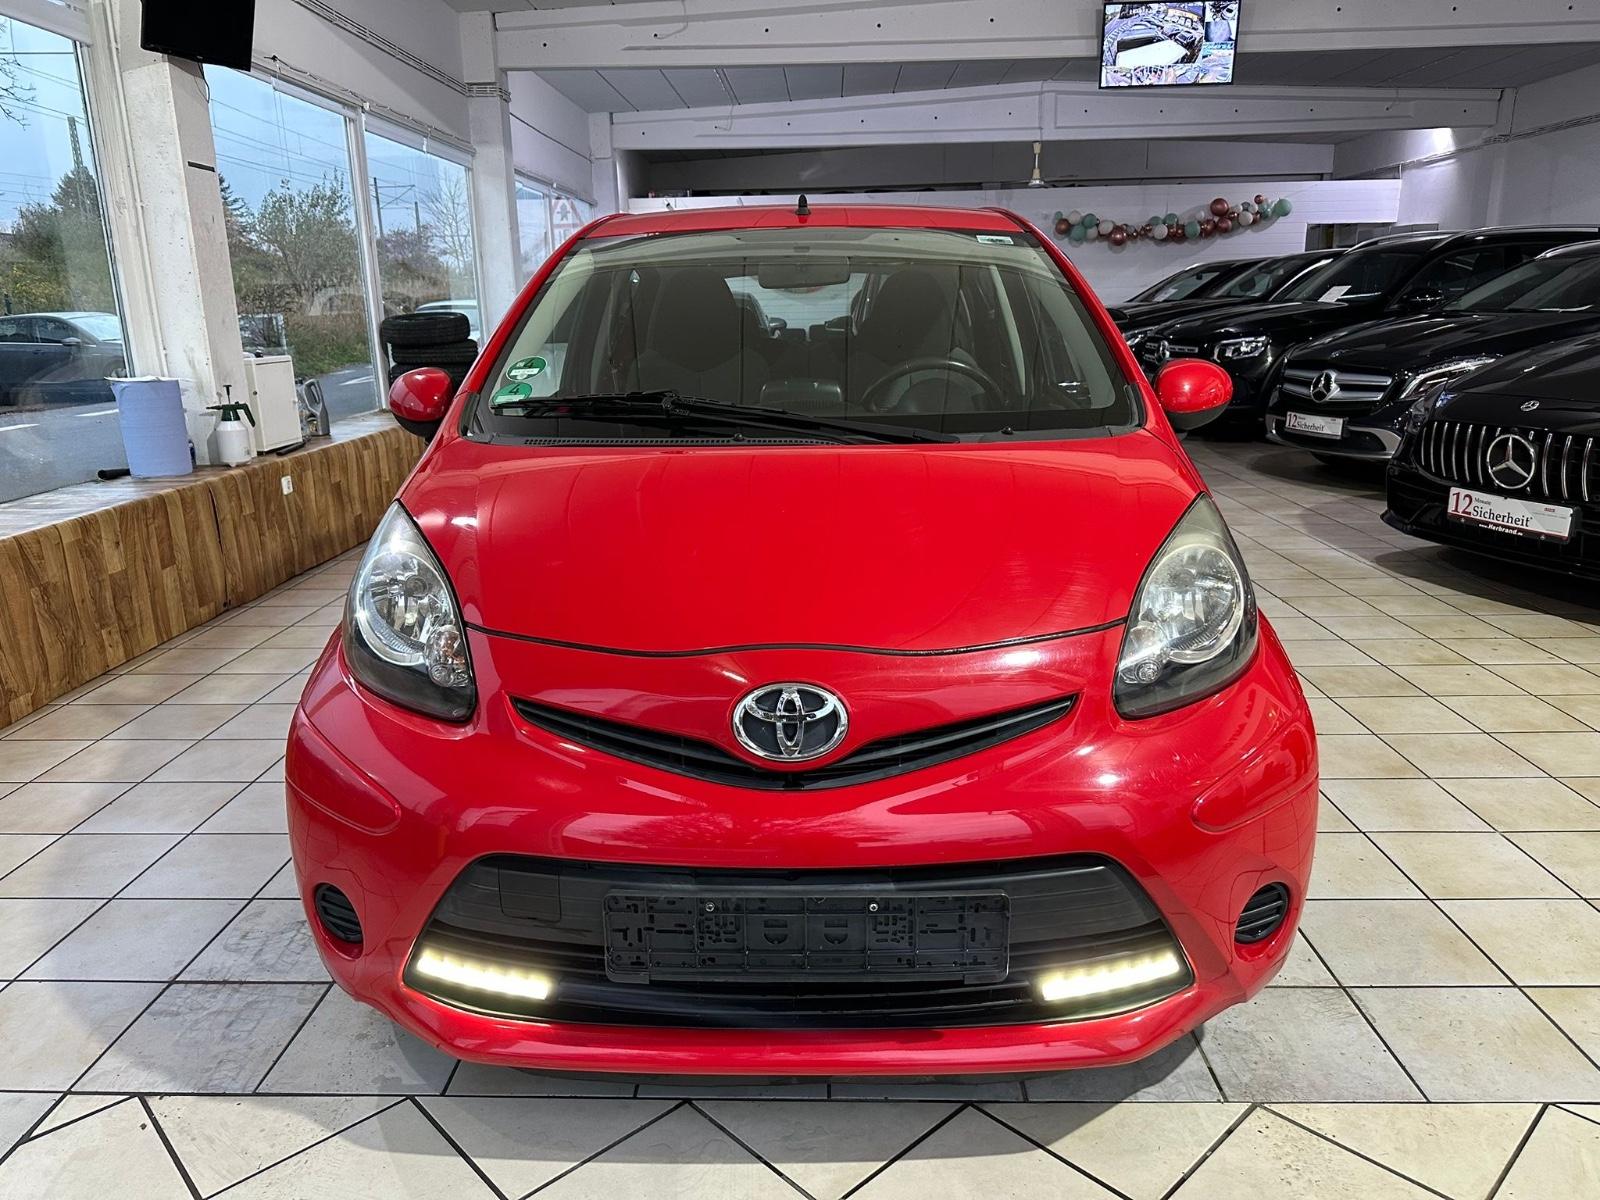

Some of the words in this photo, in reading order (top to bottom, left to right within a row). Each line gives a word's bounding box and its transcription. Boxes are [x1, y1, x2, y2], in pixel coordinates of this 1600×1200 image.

[524, 357, 535, 368] 4
[508, 383, 520, 395] 4
[1287, 413, 1298, 428] 12
[1451, 491, 1473, 517] 12
